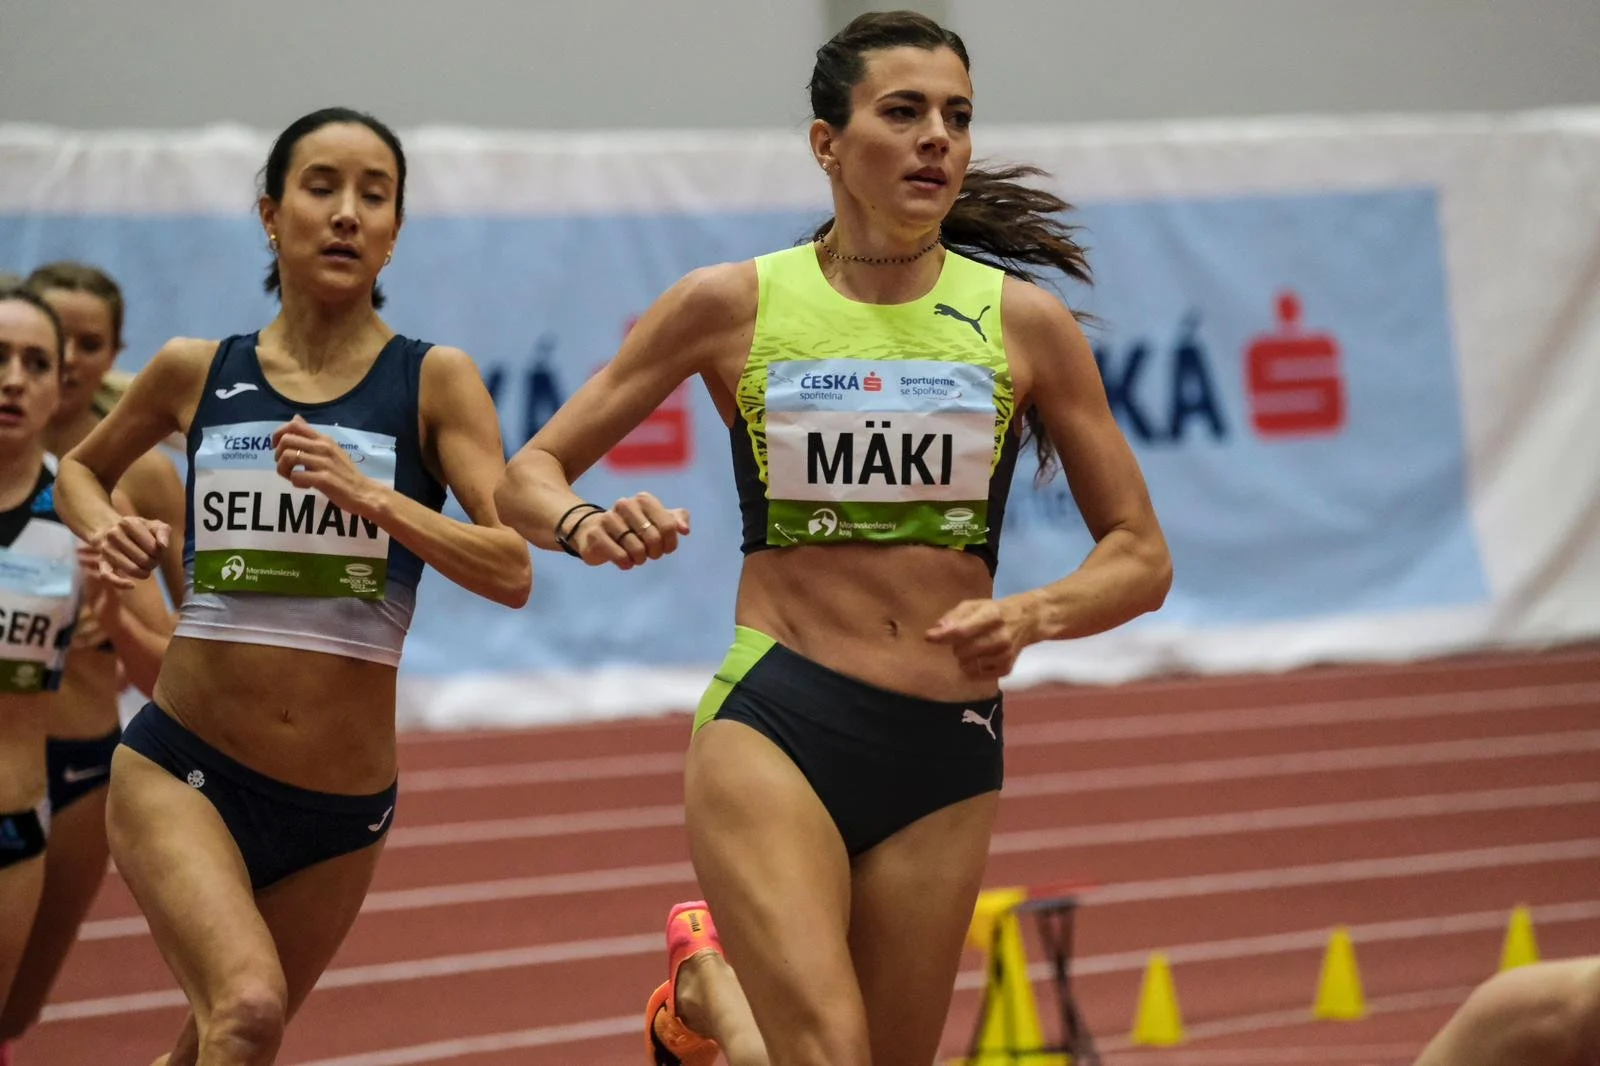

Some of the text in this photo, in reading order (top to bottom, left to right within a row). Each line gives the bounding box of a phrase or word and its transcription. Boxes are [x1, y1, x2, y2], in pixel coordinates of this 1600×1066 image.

[800, 372, 860, 391] ČESKÁ
[900, 376, 955, 388] Sportujeme
[799, 391, 843, 401] spořitelna
[912, 386, 948, 398] Spořkou
[224, 432, 273, 451] ČESKÁ
[807, 420, 953, 486] MÄKI
[203, 491, 379, 539] SELMAN
[0, 608, 52, 648] ER
